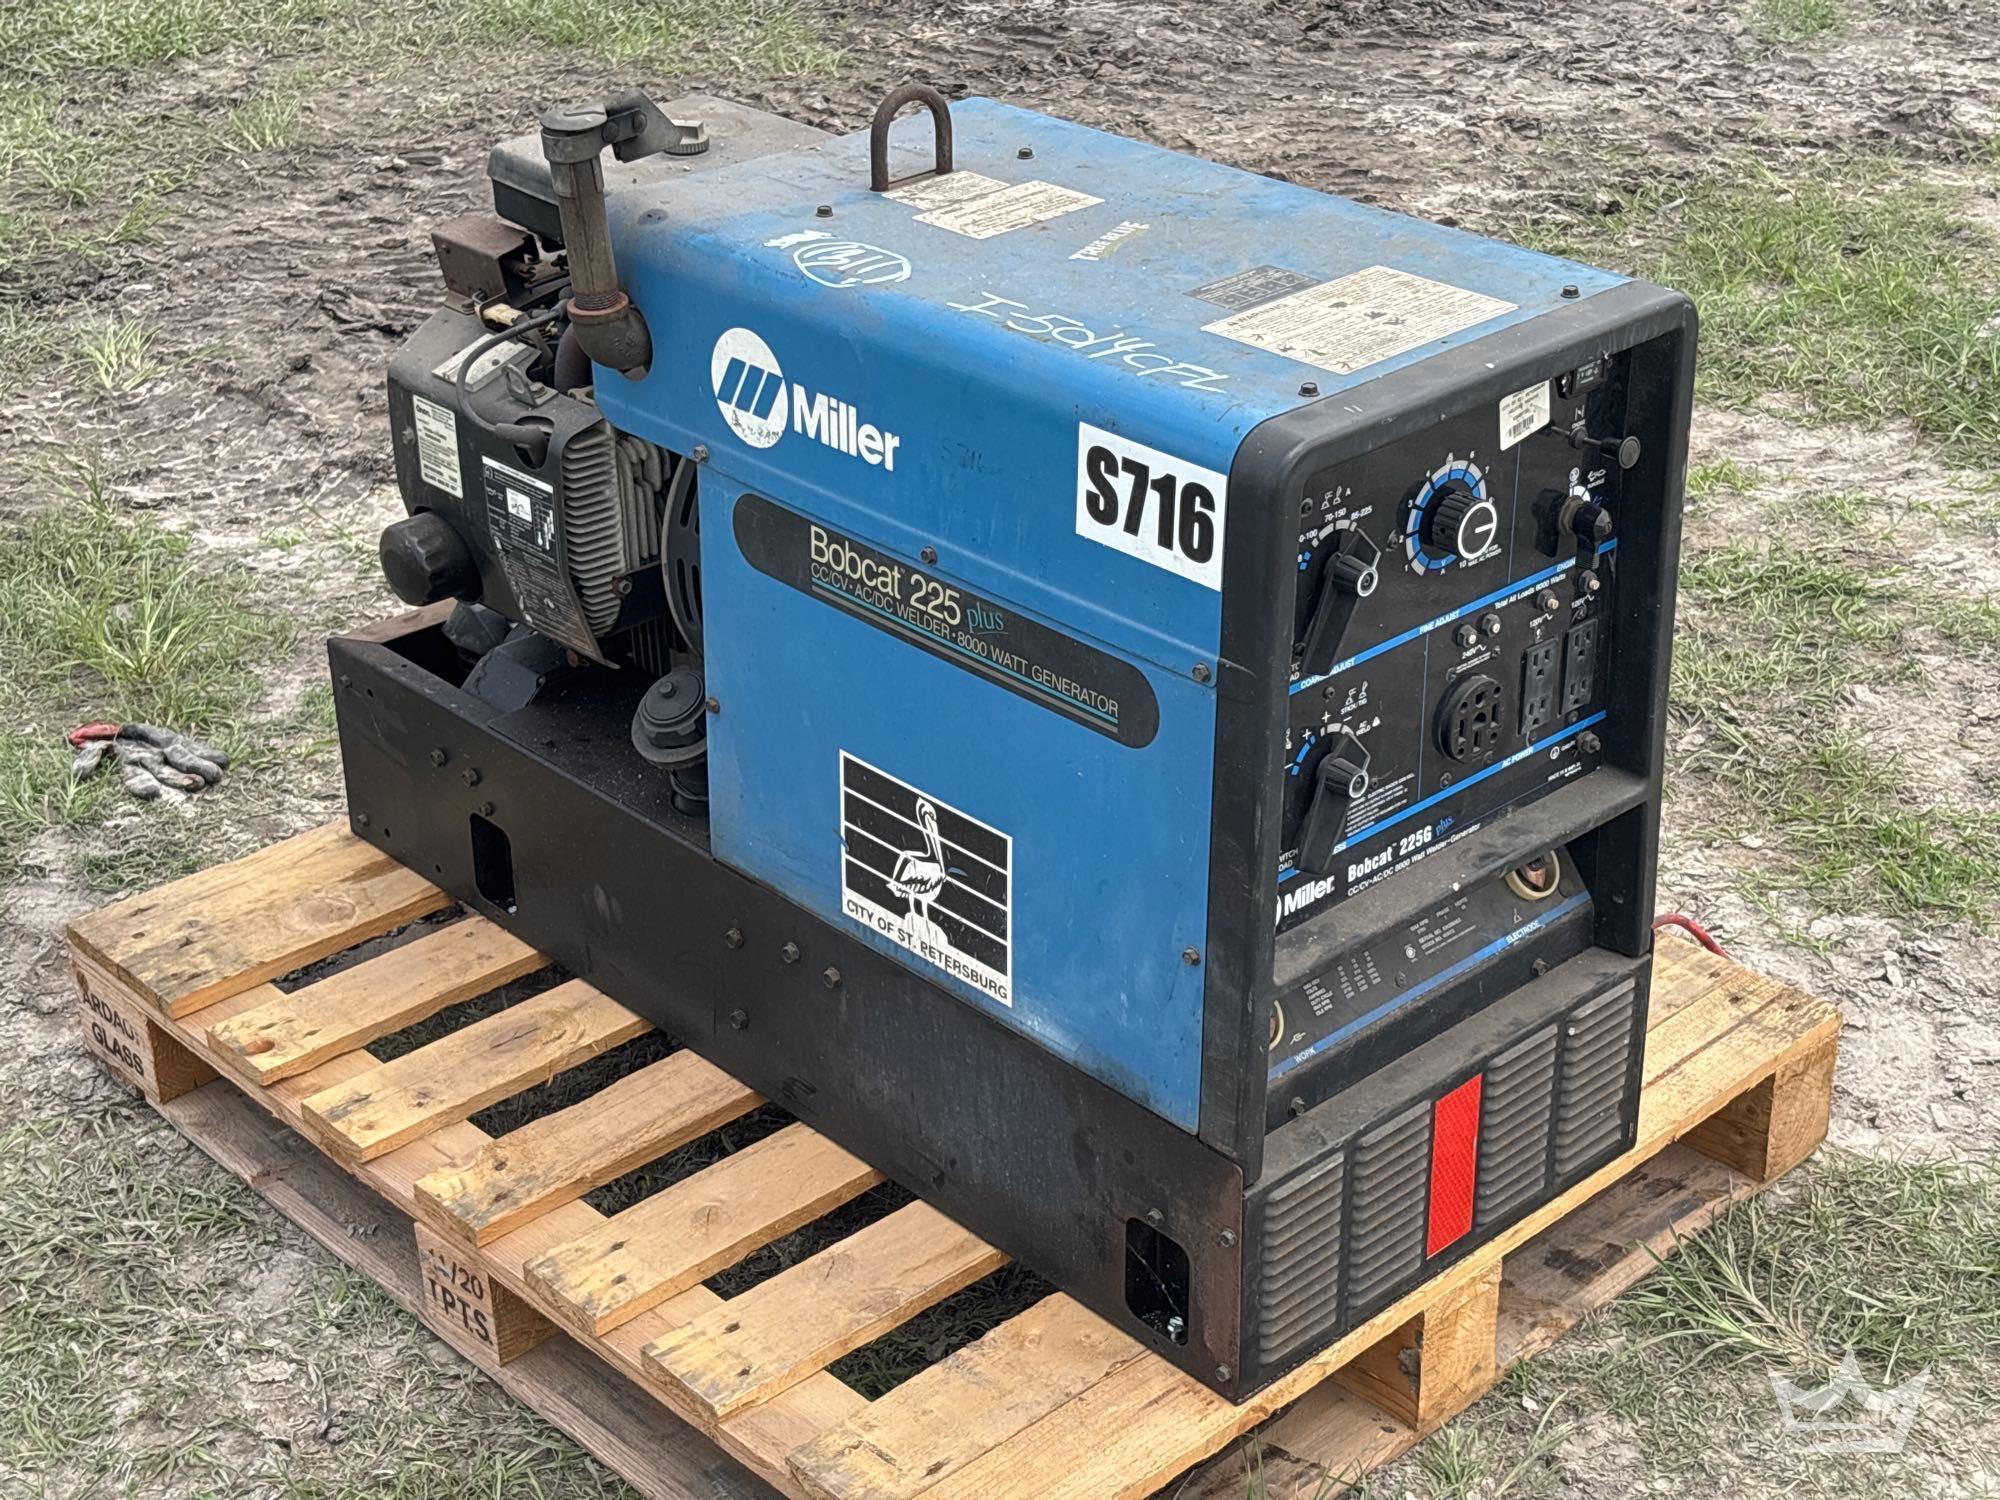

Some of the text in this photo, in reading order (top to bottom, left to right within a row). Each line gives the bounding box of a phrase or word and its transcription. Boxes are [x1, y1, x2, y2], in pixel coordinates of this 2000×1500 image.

[793, 383, 899, 471] Miller
[1086, 445, 1216, 564] S716
[811, 525, 1006, 634] Bobcat 225 plus
[1557, 556, 1577, 572] ENGIN
[1419, 609, 1460, 635] FINE ADJUST
[811, 562, 1118, 717] CC/CV AC/DC WELDER 8000 WATT GENERATOR
[1329, 657, 1356, 676] ADJUST
[1501, 746, 1534, 768] AC POWER
[1347, 845, 1393, 883] Bobcat
[1435, 816, 1455, 836] plus
[1450, 822, 1481, 843] Generator
[1279, 860, 1293, 872] OAD
[1284, 875, 1335, 917] Miller
[1506, 919, 1541, 944] ELECTRODE
[846, 899, 1008, 999] CITY OF ST. PETERSBURG
[92, 1021, 144, 1077] GLASS
[1294, 1046, 1316, 1064] WORK
